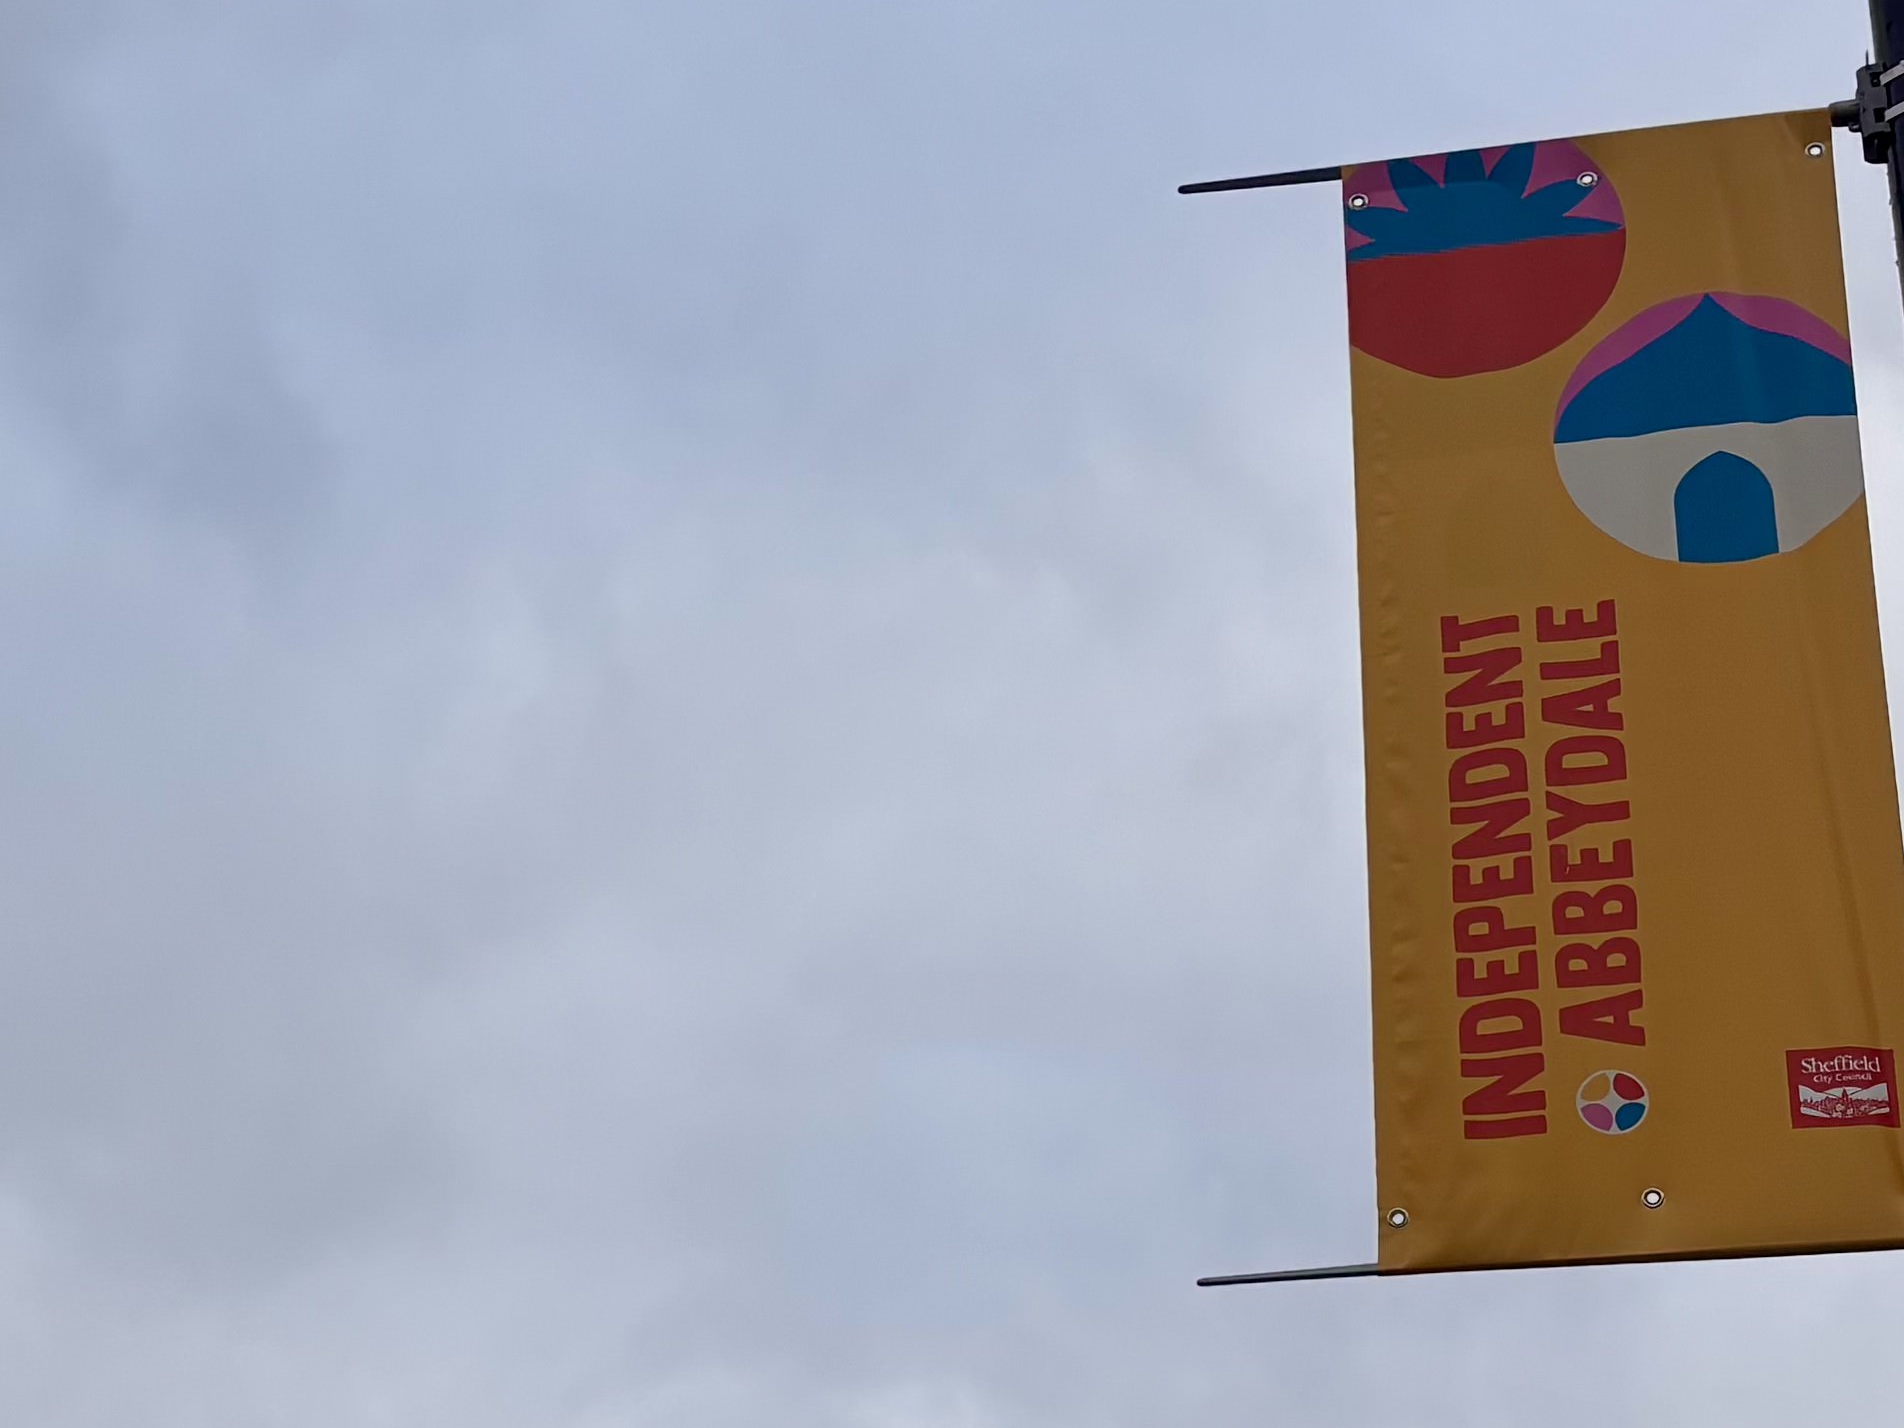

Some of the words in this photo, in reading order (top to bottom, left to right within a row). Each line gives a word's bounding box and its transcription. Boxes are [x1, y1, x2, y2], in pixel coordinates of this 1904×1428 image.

[1440, 613, 1548, 1140] INDEPENDENT
[1536, 598, 1646, 1047] ABBEYDALE
[1801, 1055, 1880, 1074] Sheffield
[1813, 1074, 1832, 1084] City
